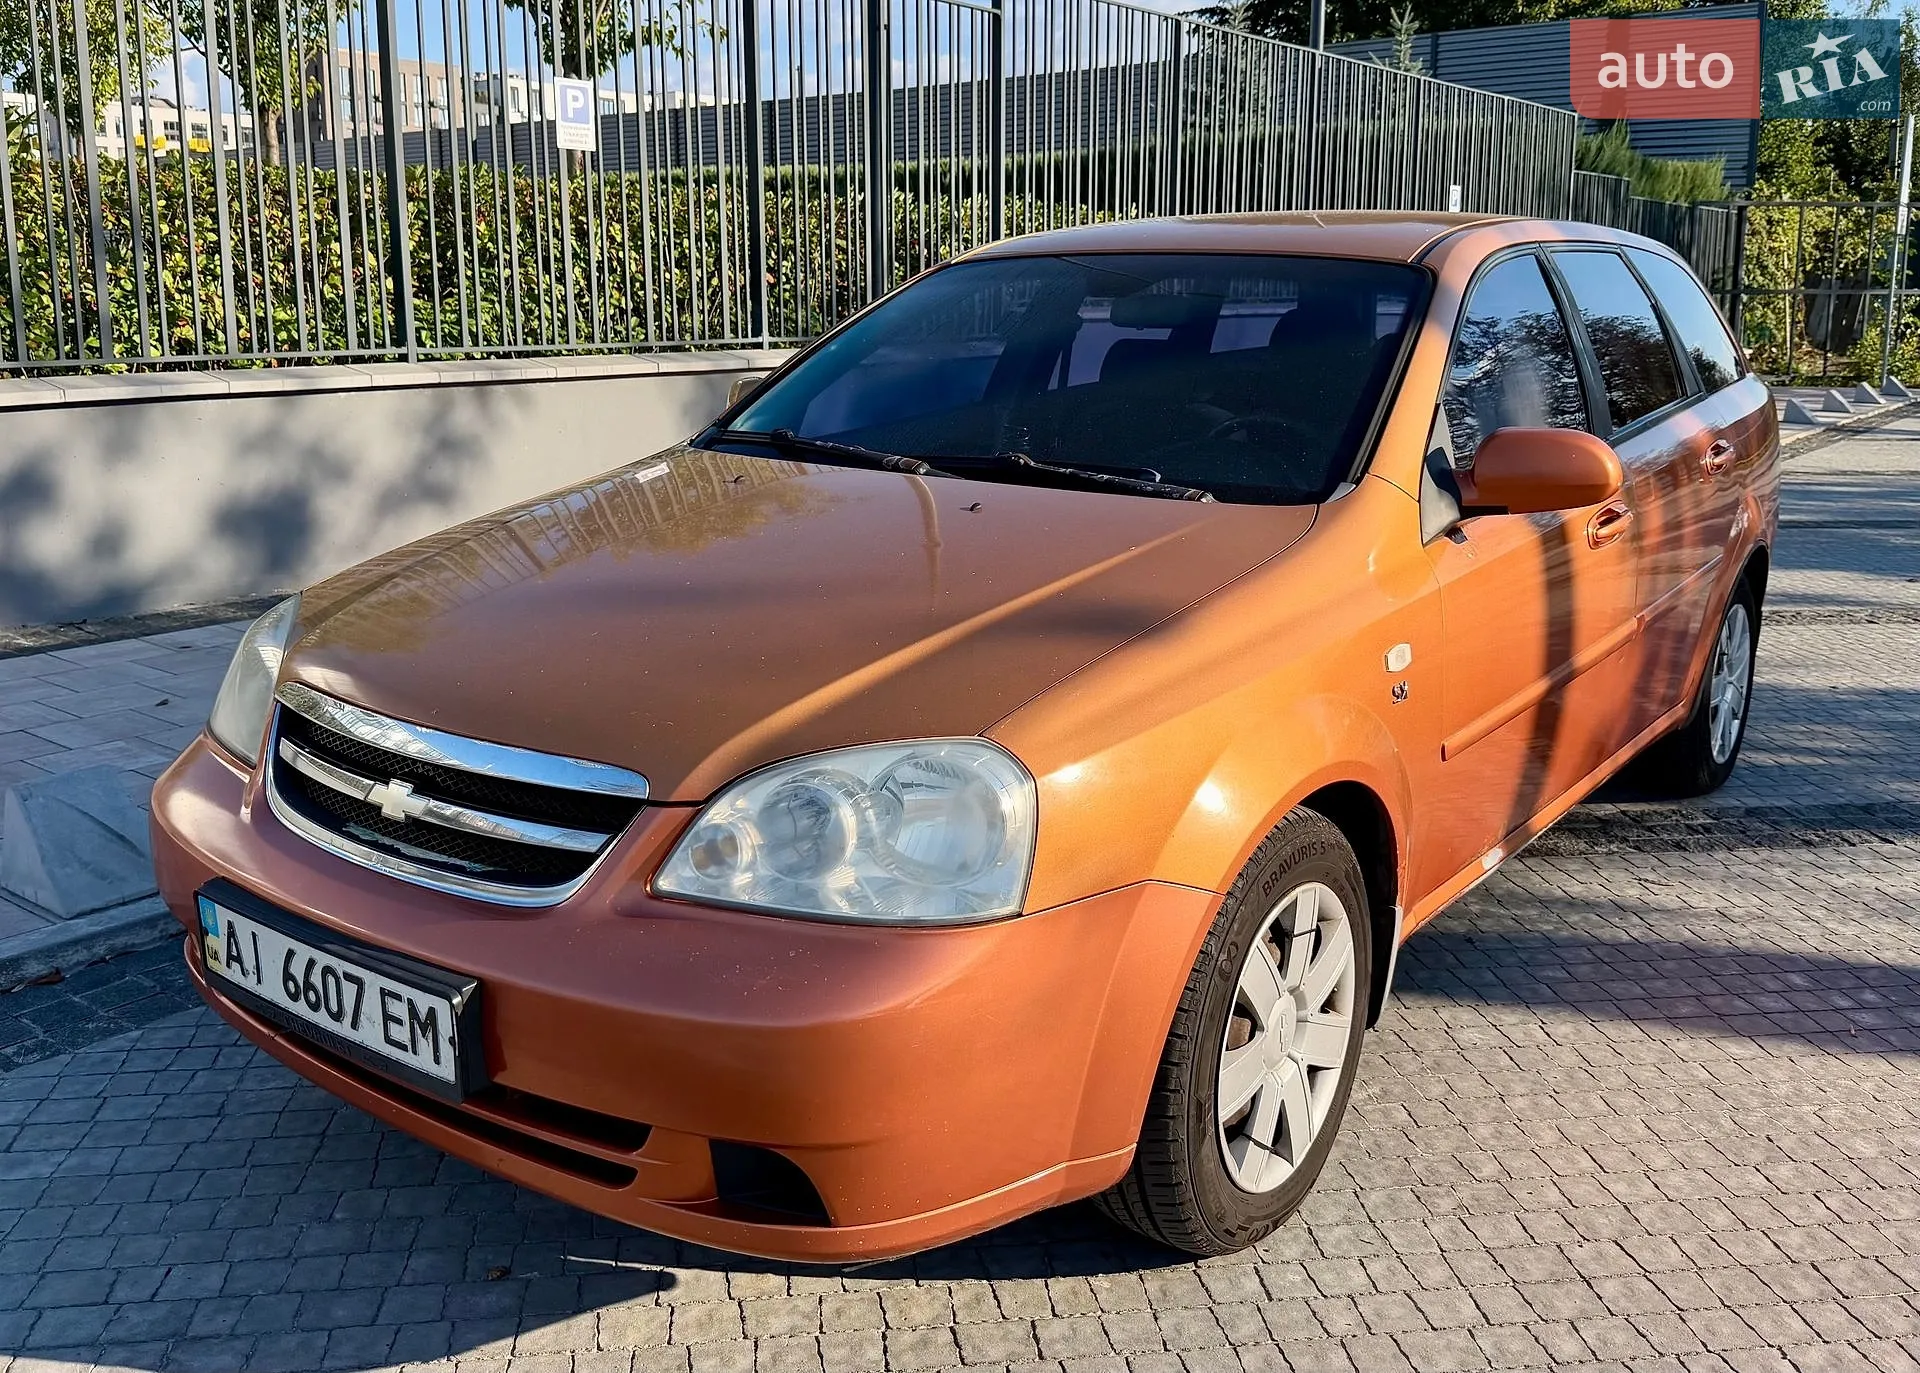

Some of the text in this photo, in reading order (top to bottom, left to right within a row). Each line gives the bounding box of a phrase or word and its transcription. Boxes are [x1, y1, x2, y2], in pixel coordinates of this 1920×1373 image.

[566, 87, 585, 119] P
[1261, 841, 1318, 898] BRAVURIS
[207, 945, 222, 964] UA
[225, 918, 264, 986] AI
[282, 948, 366, 1032] 6607
[379, 986, 441, 1066] EM
